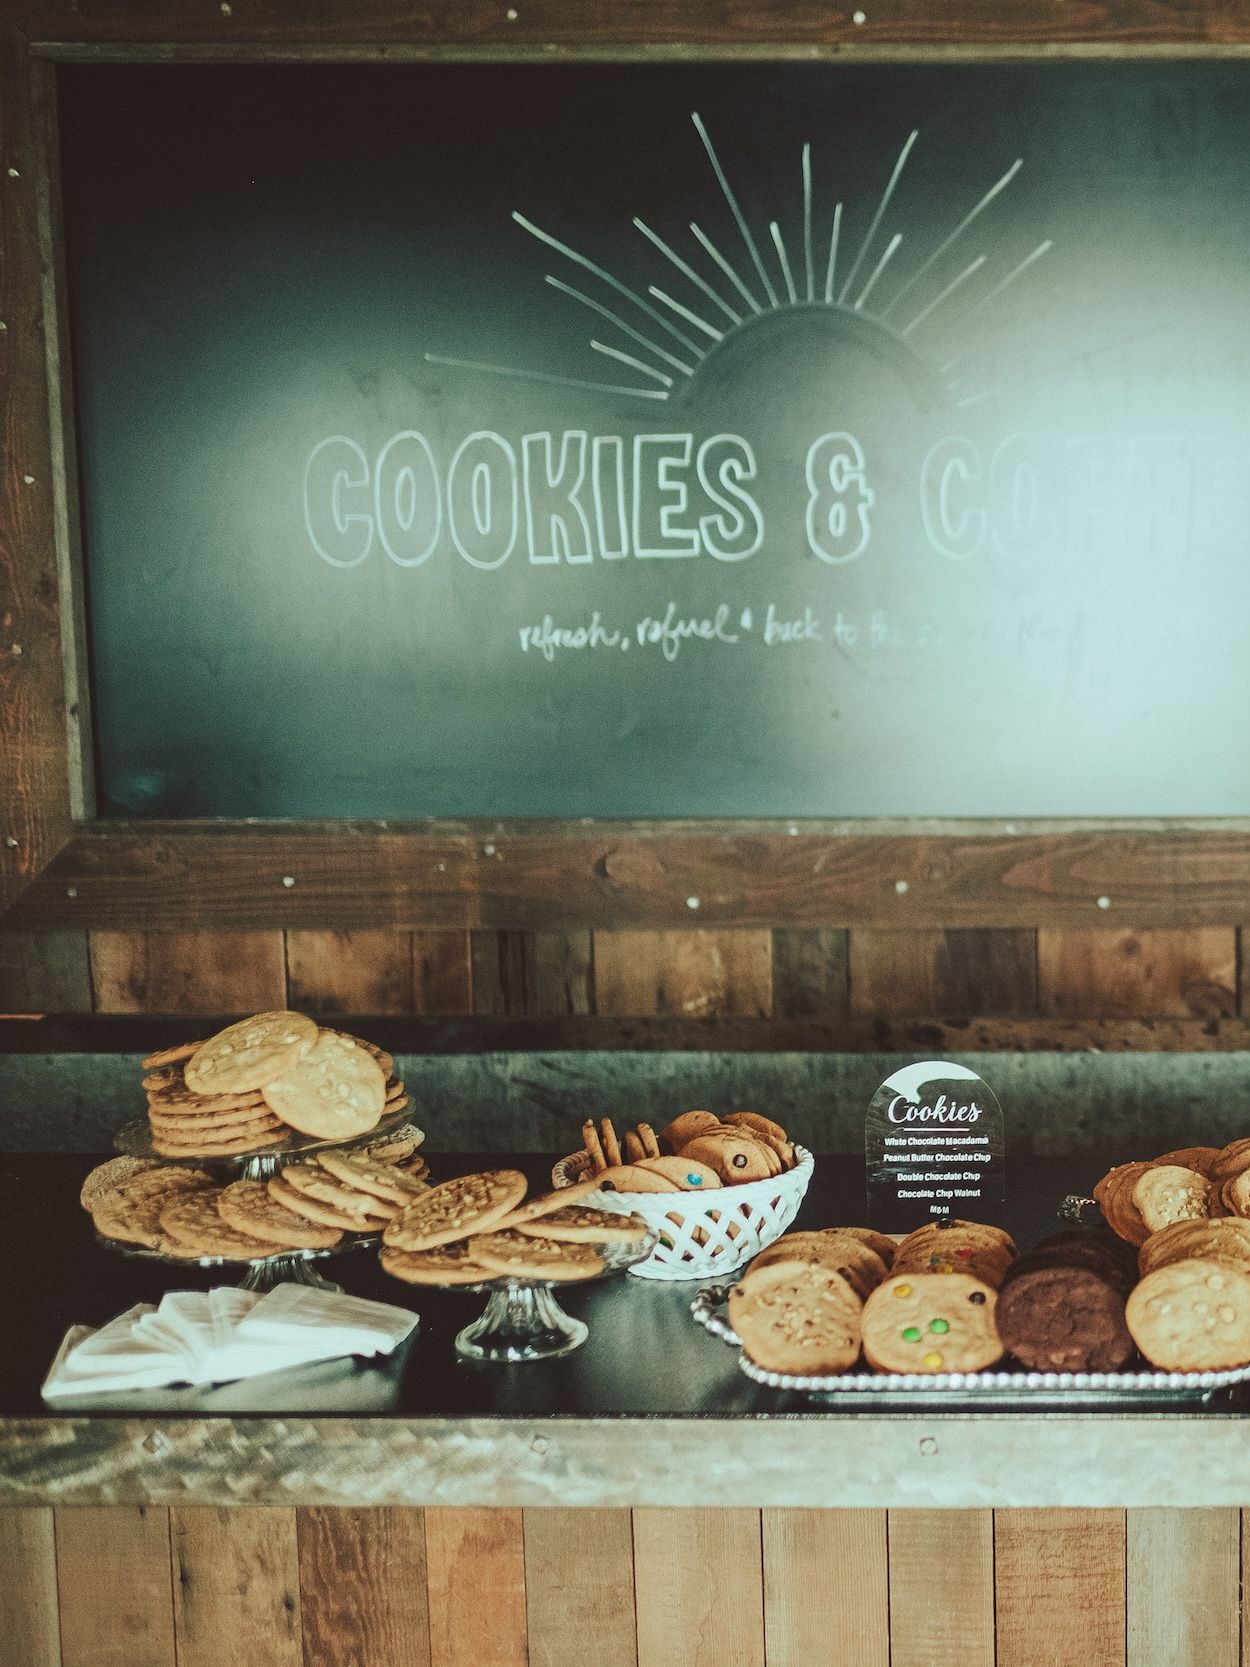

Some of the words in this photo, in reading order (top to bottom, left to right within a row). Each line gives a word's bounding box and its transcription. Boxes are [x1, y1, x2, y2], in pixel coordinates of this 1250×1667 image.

[304, 430, 764, 569] COOKIES
[806, 432, 874, 564] &
[888, 1095, 982, 1123] Cookies
[884, 1138, 907, 1146] White
[908, 1137, 945, 1145] Chocolate
[884, 1154, 911, 1162] Peanut
[911, 1154, 934, 1162] Butter
[935, 1154, 973, 1162] Chocolate
[974, 1154, 991, 1163] Chip
[897, 1173, 923, 1181] Double
[925, 1173, 961, 1181] Chocolate
[963, 1173, 980, 1181] Chip
[897, 1190, 934, 1198] Chocolate
[936, 1190, 953, 1199] Chip
[954, 1189, 980, 1197] Walnut
